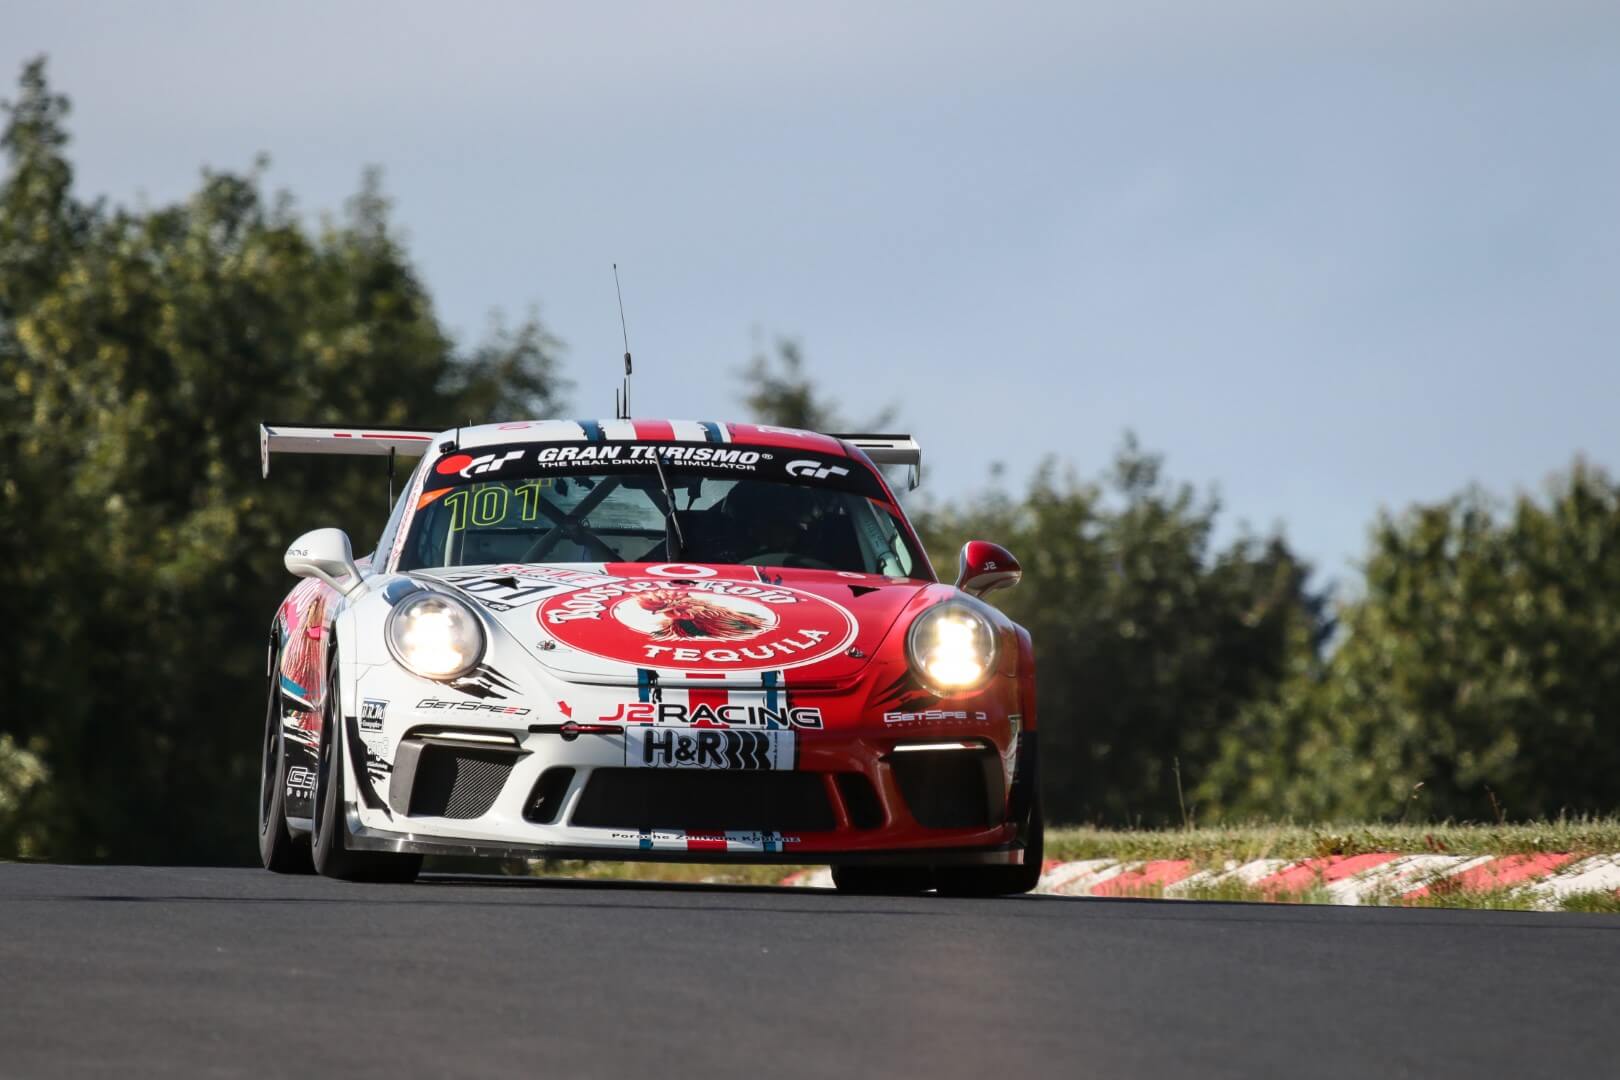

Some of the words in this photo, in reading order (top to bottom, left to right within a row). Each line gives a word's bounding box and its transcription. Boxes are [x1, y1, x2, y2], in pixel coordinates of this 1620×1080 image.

[538, 446, 622, 462] GRAN
[674, 459, 756, 471] SIMULATOR
[444, 483, 539, 531] 101
[984, 561, 996, 571] J2
[644, 629, 831, 662] TEQUILA
[598, 703, 824, 729] J2RACING
[883, 710, 987, 723] GETSPED
[611, 832, 670, 840] Porsche
